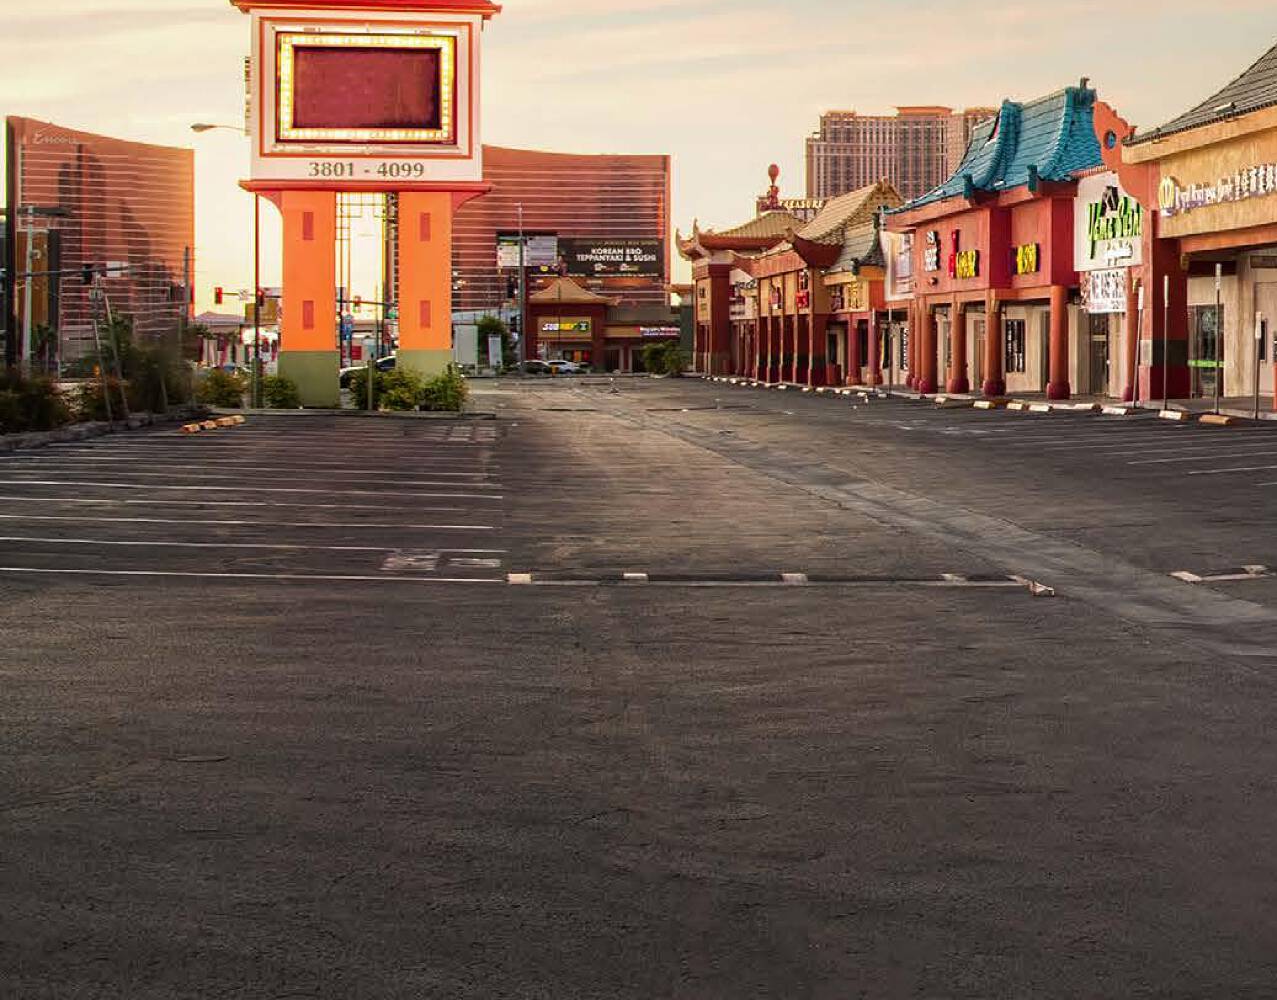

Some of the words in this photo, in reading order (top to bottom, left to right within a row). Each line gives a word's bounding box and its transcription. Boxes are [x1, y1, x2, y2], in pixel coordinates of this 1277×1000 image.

[308, 161, 354, 177] 3801
[376, 161, 424, 178] 4099
[591, 247, 624, 255] KOREAN
[633, 254, 657, 262] SUSHI
